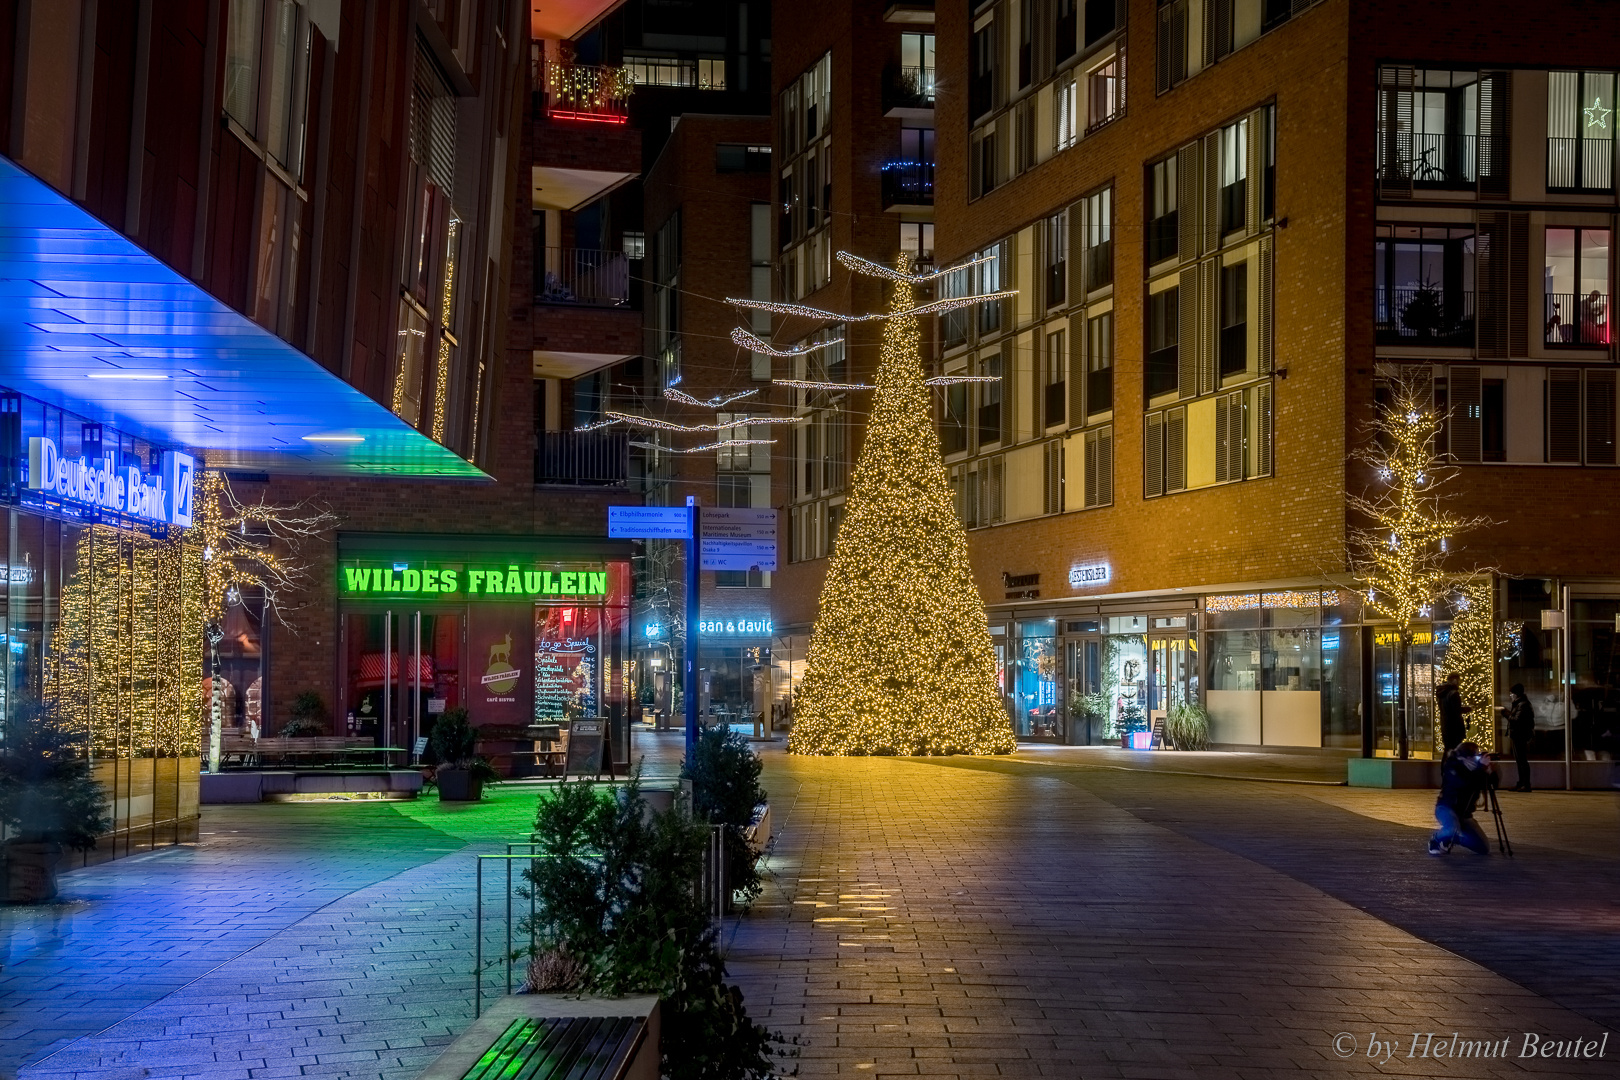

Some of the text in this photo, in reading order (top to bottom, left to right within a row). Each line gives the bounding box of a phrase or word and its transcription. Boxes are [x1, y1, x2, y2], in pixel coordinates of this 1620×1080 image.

[36, 437, 167, 522] Deutsche Bank
[345, 565, 607, 595] WILDES FRÄULEIN
[700, 621, 723, 632] ean
[726, 621, 735, 632] &
[541, 637, 589, 650] to go Special
